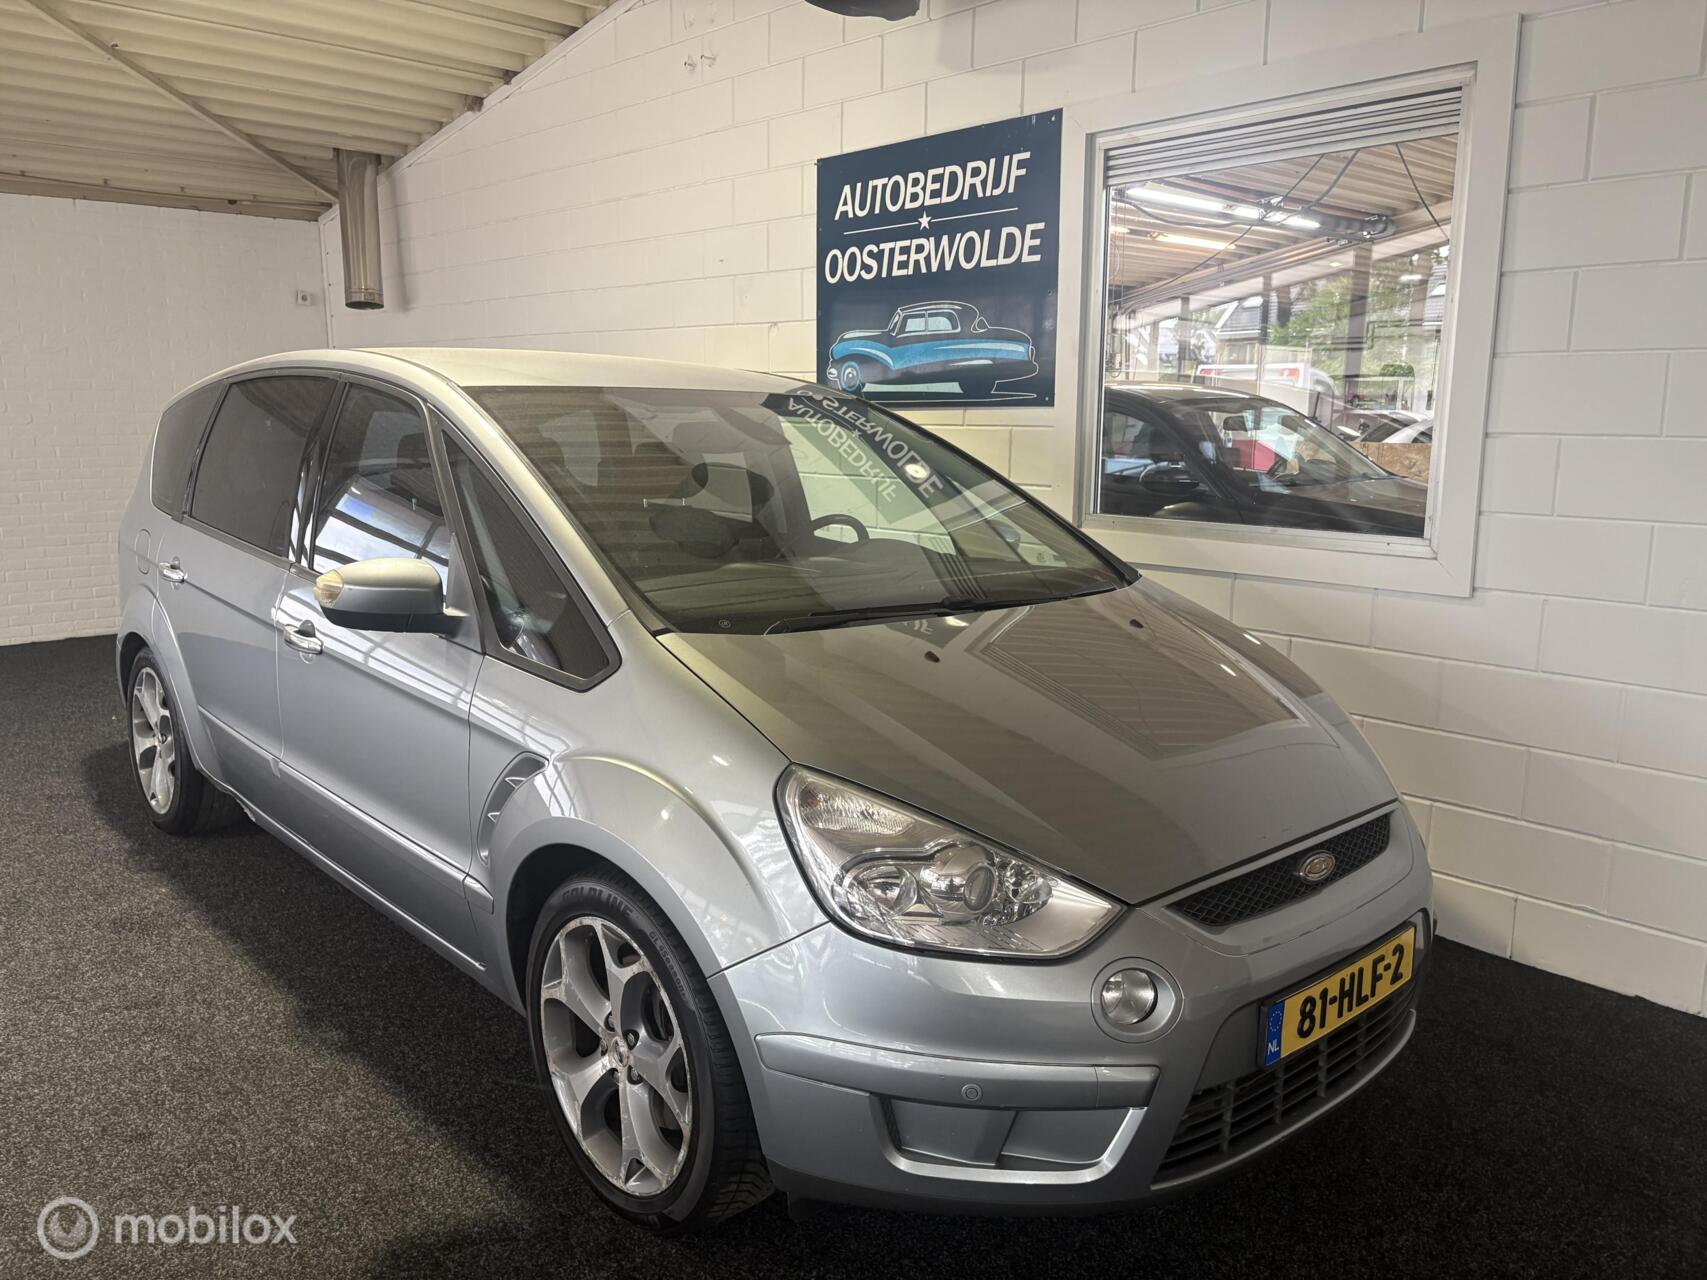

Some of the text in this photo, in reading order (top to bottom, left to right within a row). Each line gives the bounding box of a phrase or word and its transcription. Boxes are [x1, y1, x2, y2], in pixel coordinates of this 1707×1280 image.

[834, 152, 1031, 220] AUTOBEDRIJF
[824, 222, 1045, 284] OOSTERWOLDE
[1297, 943, 1405, 1038] 81-HLF-2
[1267, 1040, 1280, 1056] NL
